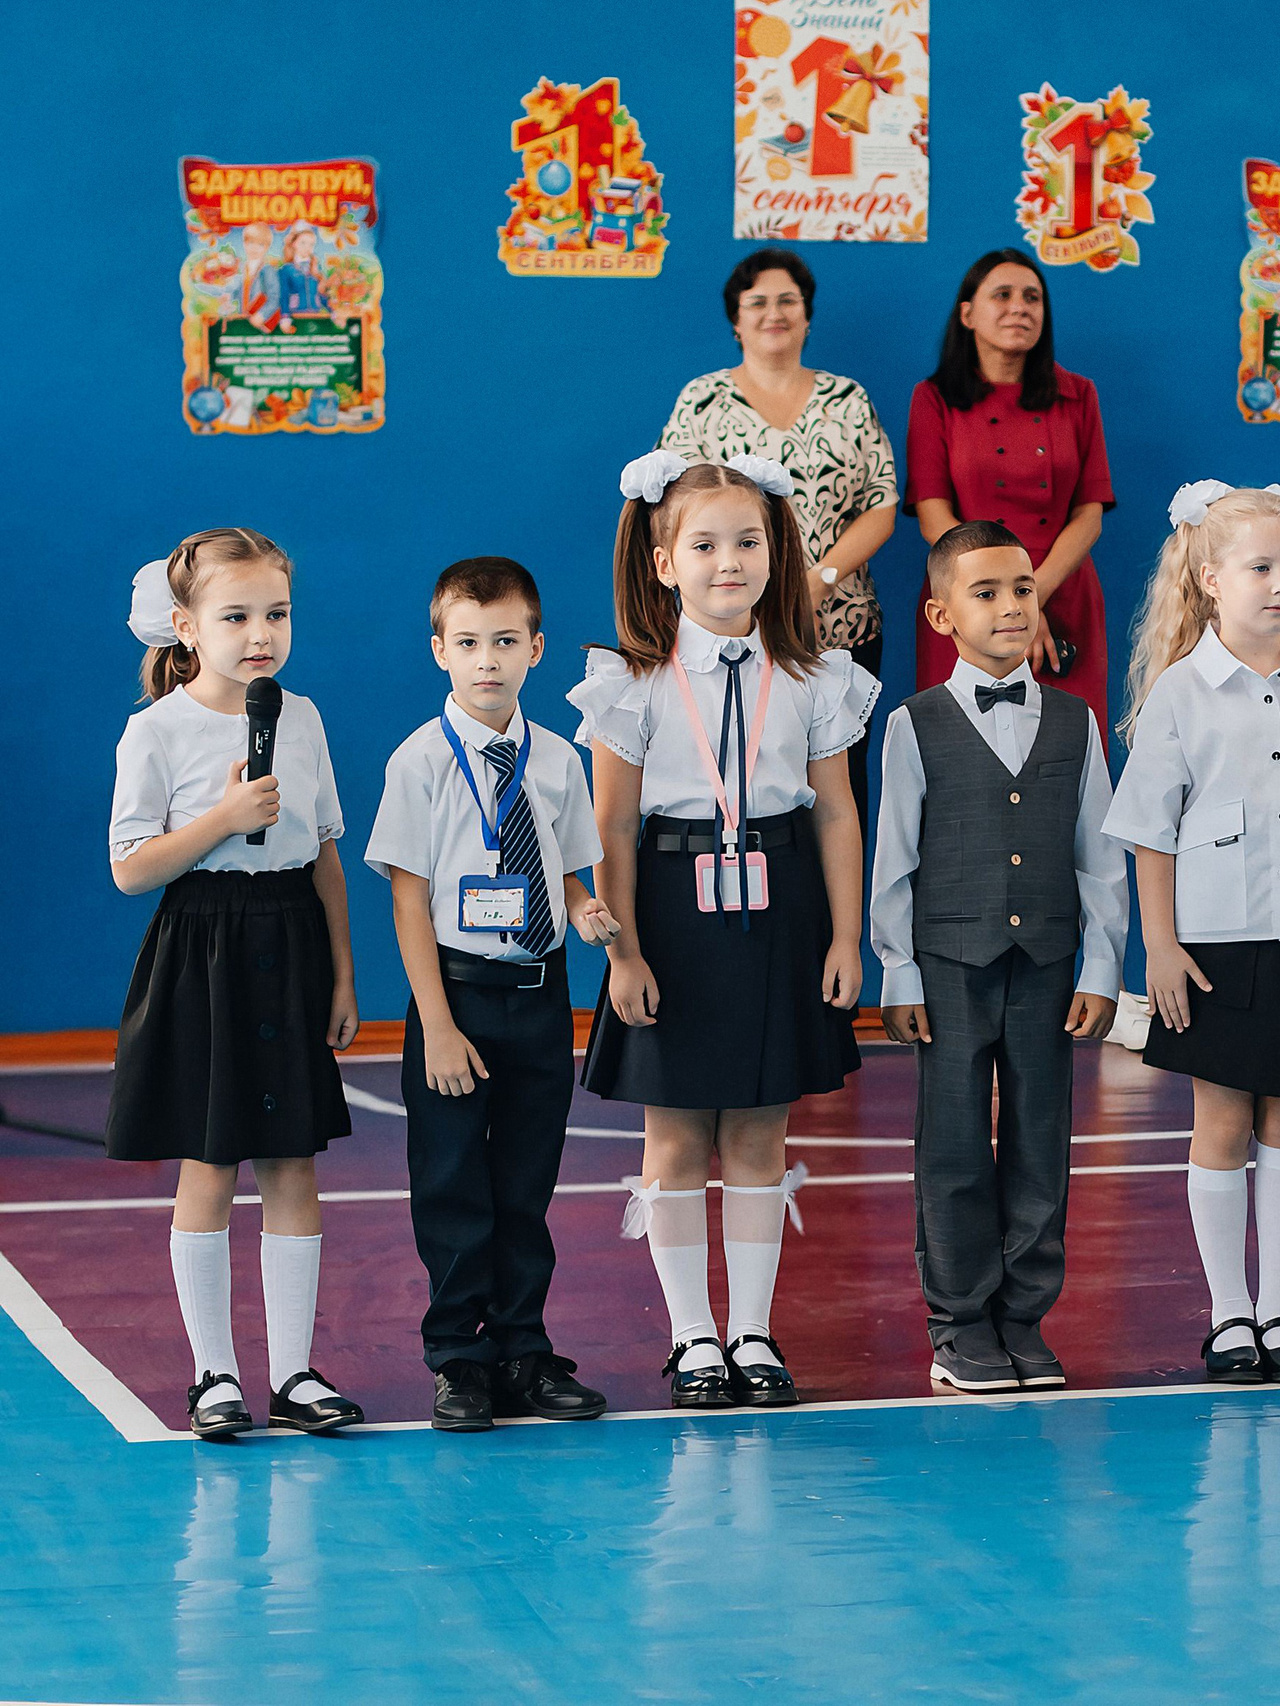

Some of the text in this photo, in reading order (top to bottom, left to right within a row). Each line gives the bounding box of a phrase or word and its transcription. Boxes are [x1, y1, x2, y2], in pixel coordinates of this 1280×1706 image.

[790, 6, 885, 31] Знаний
[791, 37, 853, 176] 1
[513, 78, 619, 222] 1
[1043, 107, 1113, 236] 1
[188, 163, 372, 198] ЗДРАВСТВУЙ,
[752, 173, 913, 223] сентября
[220, 194, 339, 223] ШКОЛА!
